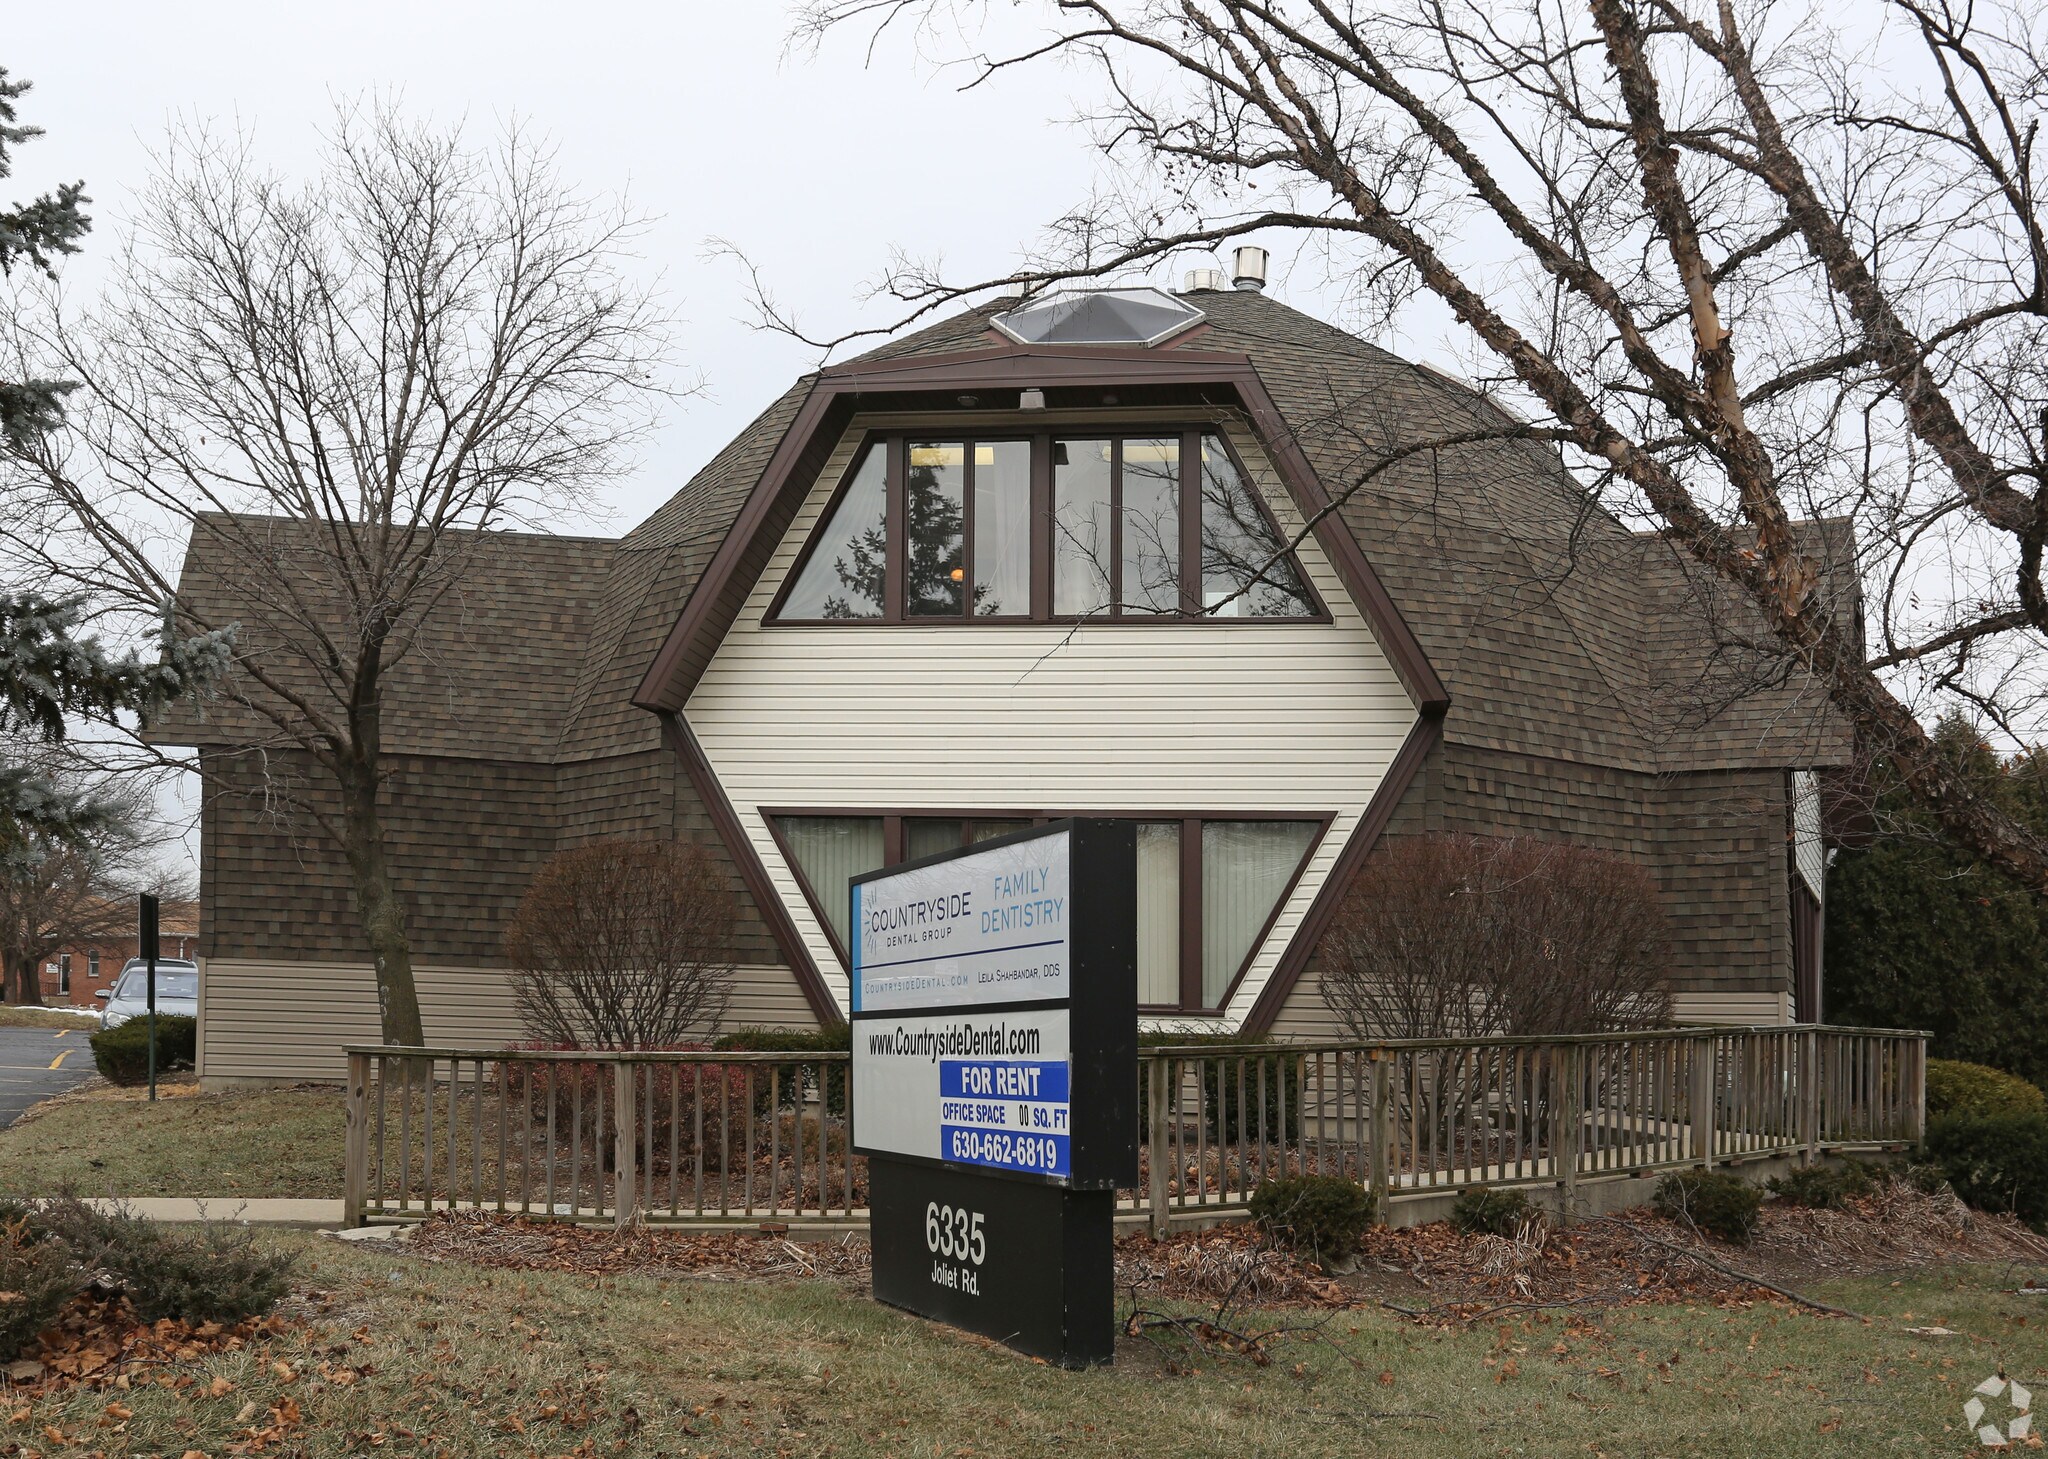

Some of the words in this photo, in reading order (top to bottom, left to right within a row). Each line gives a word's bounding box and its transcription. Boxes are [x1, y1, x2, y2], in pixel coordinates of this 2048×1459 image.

[995, 866, 1049, 900] FAMILY
[871, 891, 972, 933] COUNTRYSIDE
[981, 897, 1064, 934] DENTISTRY
[887, 930, 918, 948] DENTAL
[922, 926, 952, 943] GROUP
[1043, 963, 1060, 977] DDS
[869, 1021, 1040, 1063] www.CountrysideDental.com
[961, 1066, 992, 1095] FOR
[996, 1067, 1041, 1096] RENT
[943, 1102, 974, 1122] OFFICE
[976, 1106, 1006, 1124] SPACE
[1018, 1104, 1029, 1127] 00
[1033, 1108, 1051, 1129] SQ.
[1054, 1109, 1068, 1129] FT
[952, 1130, 1057, 1170] 630-662-6819
[926, 1201, 986, 1266] 6335
[931, 1260, 958, 1289] Joliet
[962, 1269, 980, 1297] Rd.
